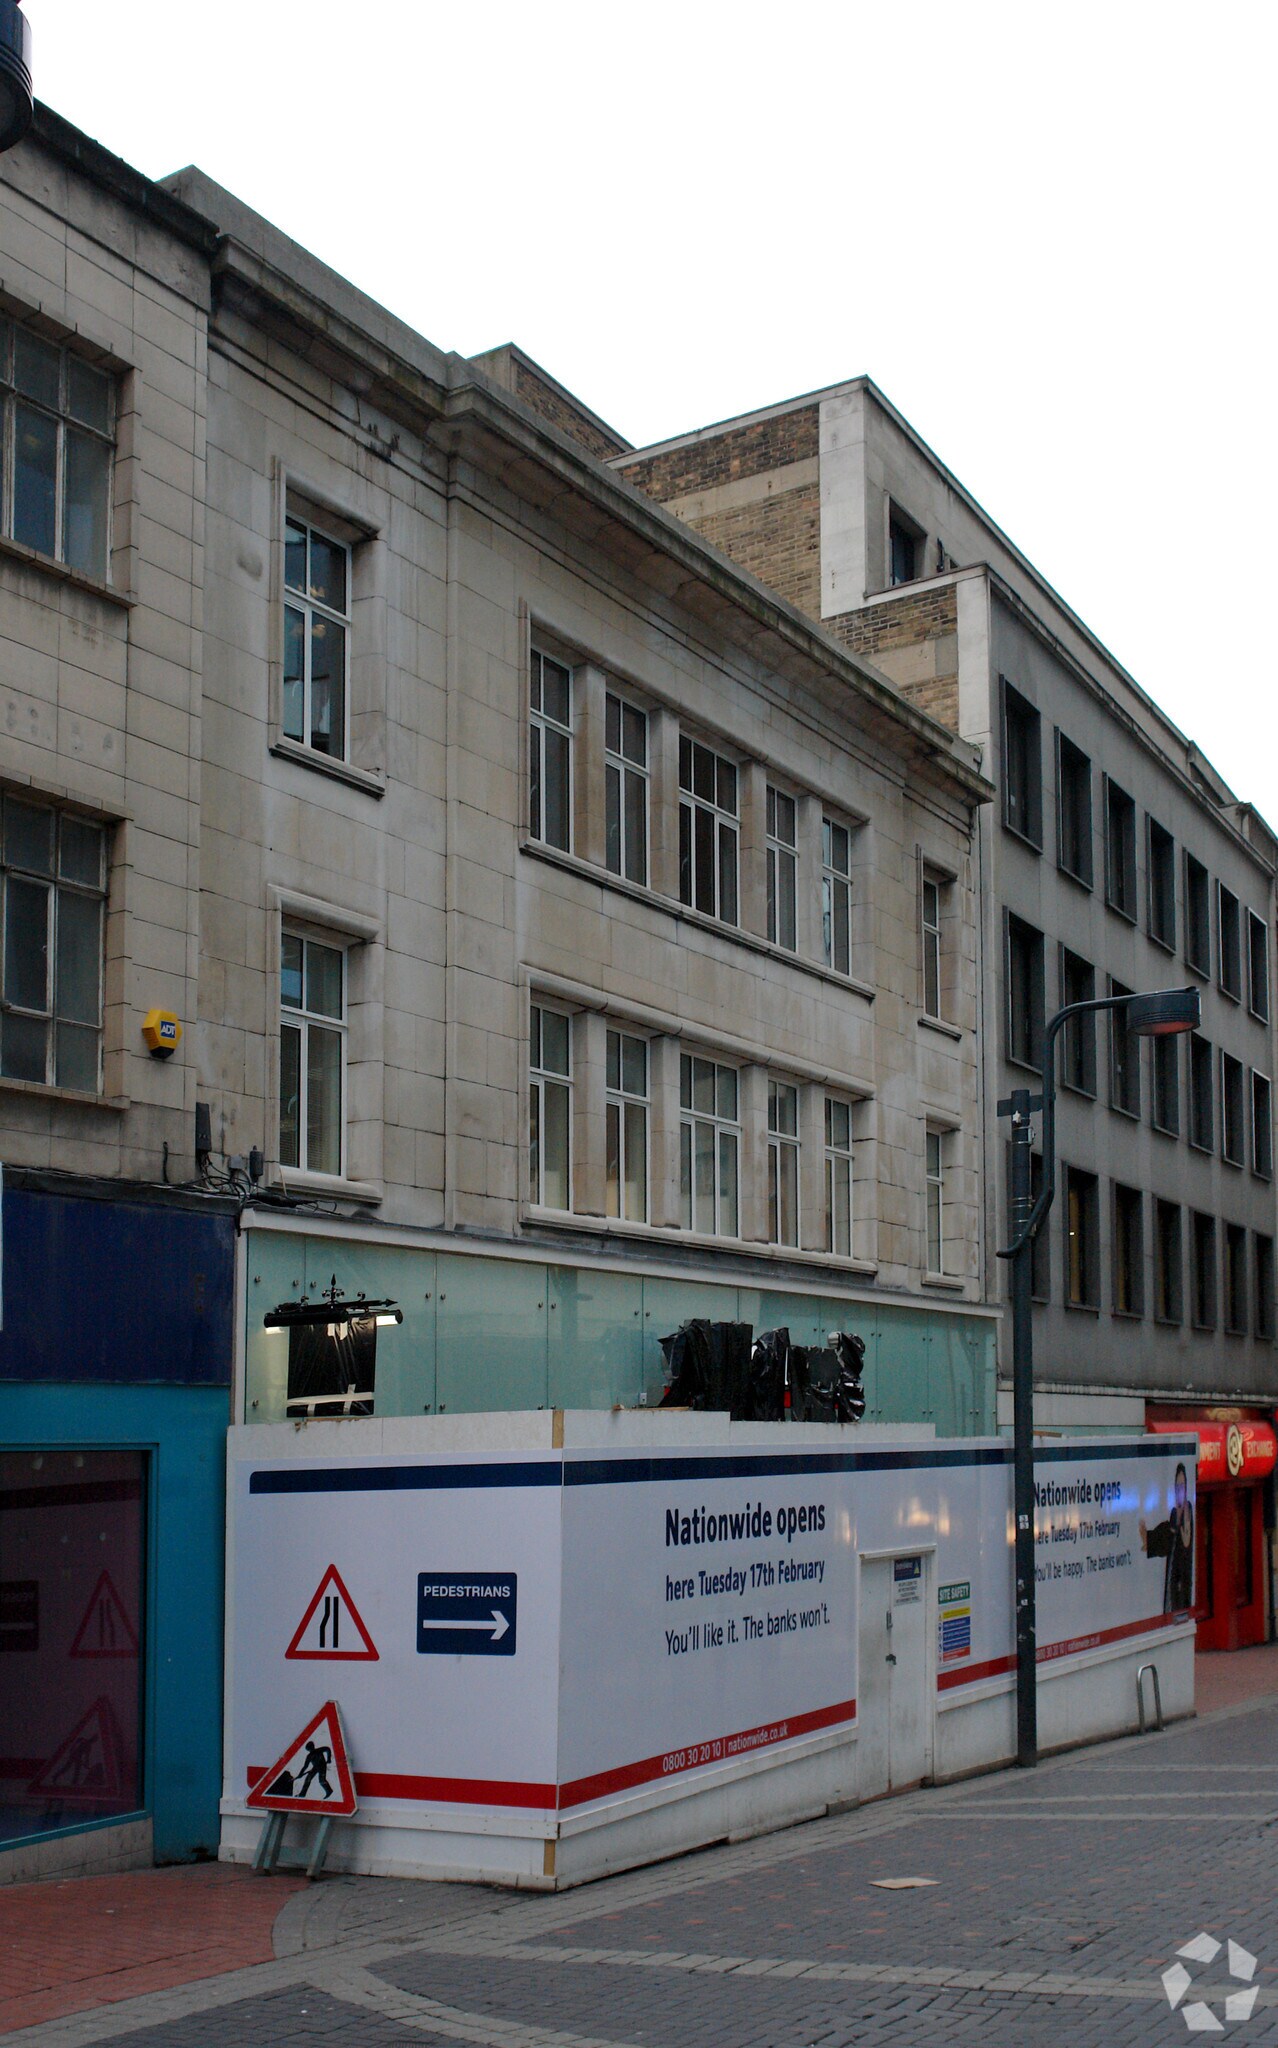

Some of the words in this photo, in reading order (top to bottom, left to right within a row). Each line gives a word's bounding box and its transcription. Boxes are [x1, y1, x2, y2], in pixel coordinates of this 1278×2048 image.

[161, 1024, 175, 1035] ADT
[1034, 1478, 1092, 1508] Nationwide
[1094, 1481, 1121, 1507] opens
[666, 1502, 772, 1547] Nationwide
[777, 1504, 825, 1543] opens
[1051, 1524, 1078, 1544] Tuesday
[1079, 1521, 1094, 1540] 17th
[1095, 1520, 1120, 1538] February
[1053, 1561, 1062, 1578] be
[1086, 1556, 1097, 1573] The
[1098, 1553, 1115, 1571] banks
[423, 1585, 511, 1598] PEDESTRIANS
[666, 1575, 694, 1601] here
[699, 1567, 746, 1596] Tuesday
[750, 1561, 774, 1588] 17th
[778, 1558, 825, 1583] February
[939, 1588, 951, 1602] SITE
[951, 1585, 969, 1600] SAFETY
[665, 1625, 699, 1656] You'll
[703, 1623, 723, 1649] like
[727, 1620, 738, 1644] it.
[743, 1616, 763, 1641] The
[767, 1609, 797, 1636] banks
[799, 1603, 830, 1629] won't.
[662, 1753, 686, 1773] 0800
[687, 1748, 699, 1766] 30
[700, 1744, 711, 1761] 20
[712, 1741, 722, 1757] 10
[728, 1722, 788, 1753] nationwide.co.uk
